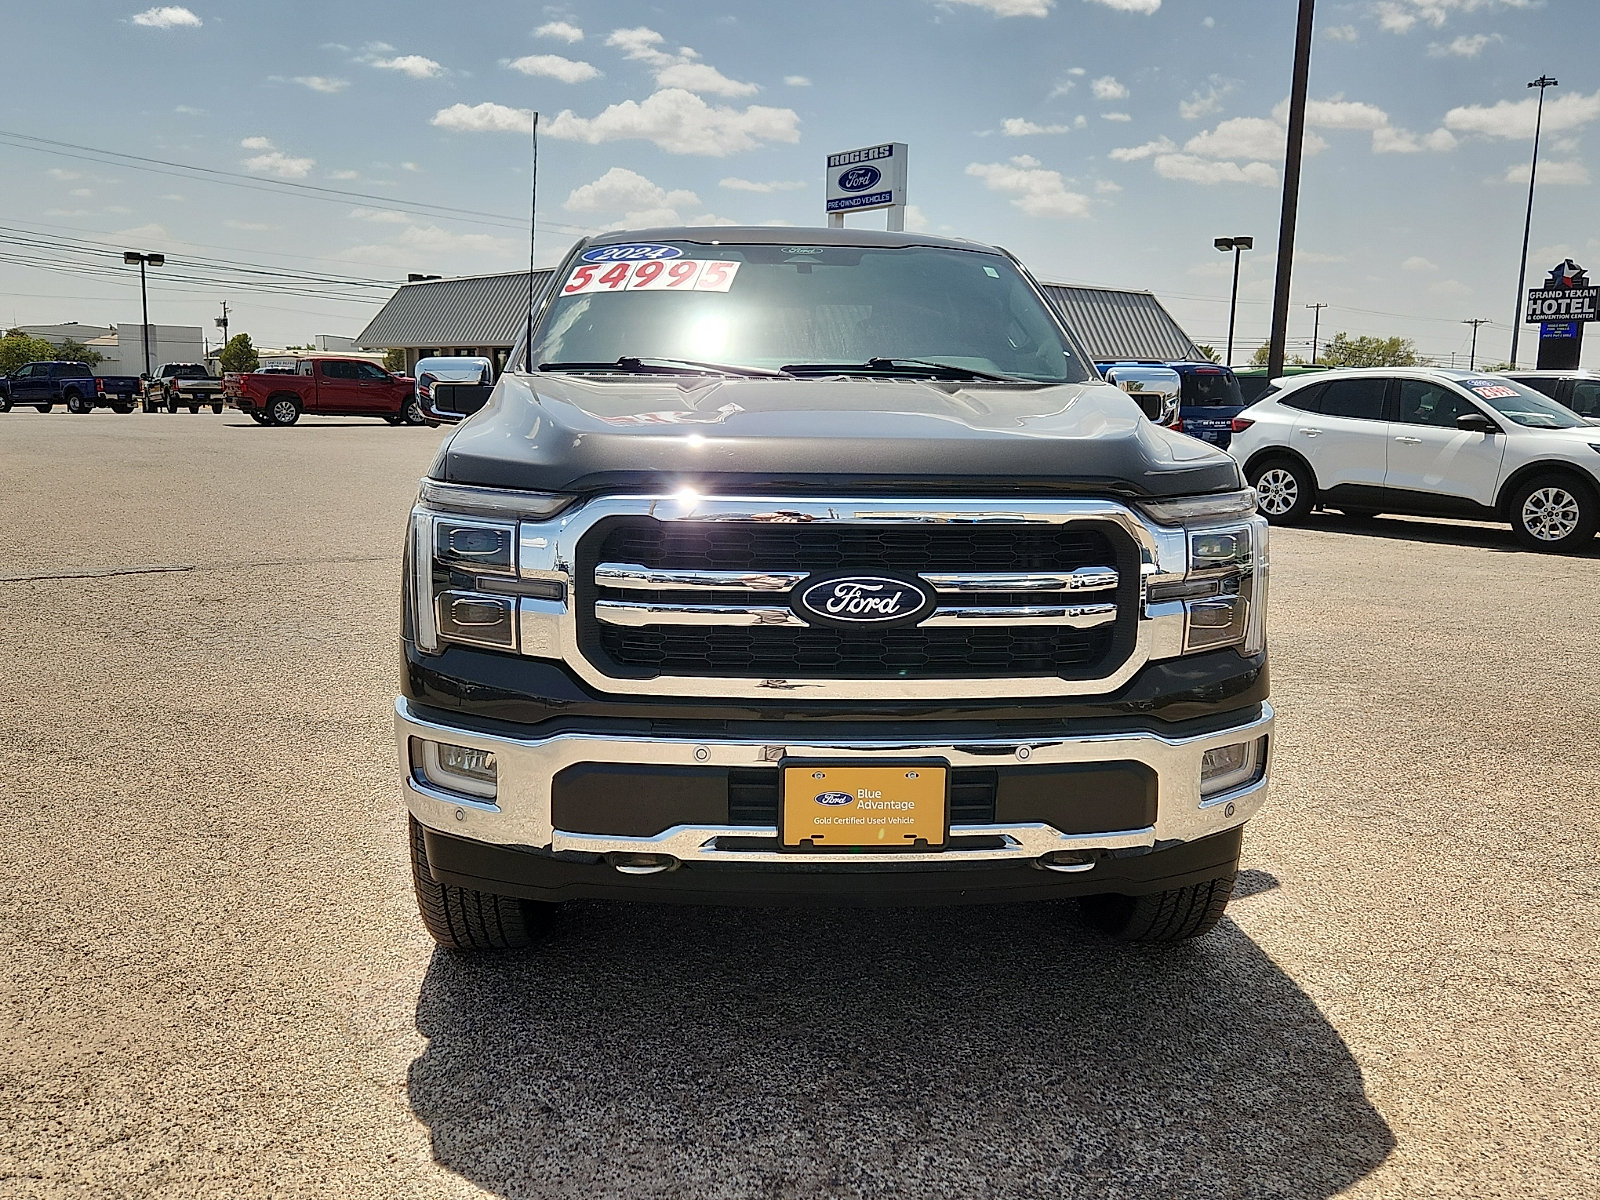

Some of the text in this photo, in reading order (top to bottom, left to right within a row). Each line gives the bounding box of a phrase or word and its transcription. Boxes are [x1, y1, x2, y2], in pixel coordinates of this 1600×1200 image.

[830, 146, 889, 166] ROGERS
[846, 170, 871, 187] Ford
[828, 194, 890, 209] PRE-OWNED VEHICLES
[593, 247, 665, 261] 2024
[564, 261, 736, 293] 54995
[1530, 289, 1596, 299] GRAND TEXAN
[1528, 298, 1594, 314] HOTEL
[825, 582, 903, 614] Ford
[821, 793, 848, 804] Ford
[857, 788, 882, 799] Blue
[856, 799, 915, 811] Advantage
[813, 816, 915, 825] Gold Certified Used Vehicle
